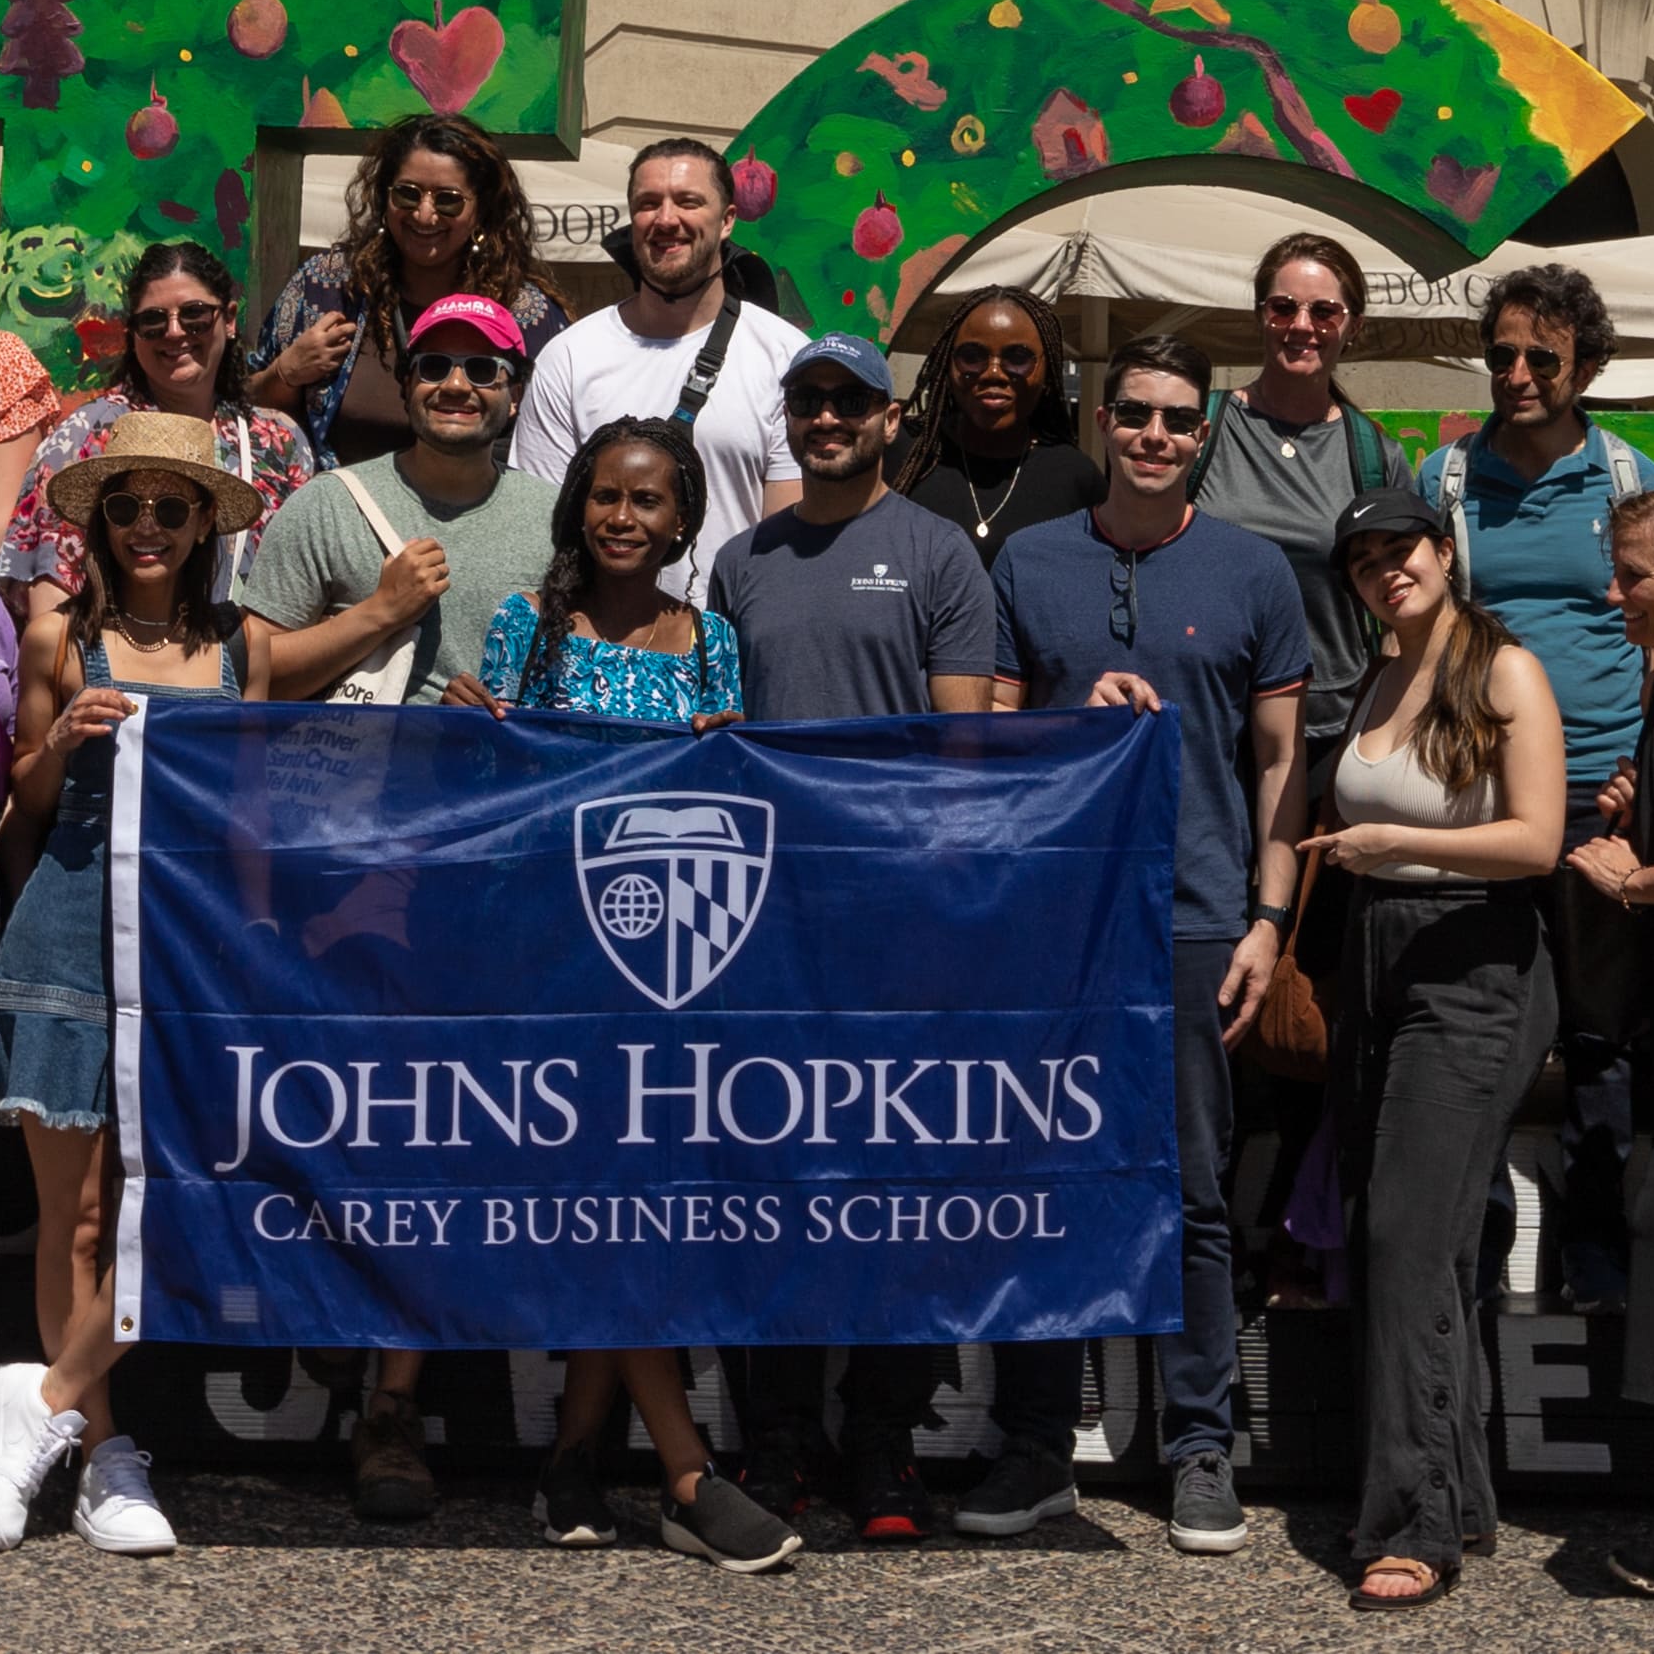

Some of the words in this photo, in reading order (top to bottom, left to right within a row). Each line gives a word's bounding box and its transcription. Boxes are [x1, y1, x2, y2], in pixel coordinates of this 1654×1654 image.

[214, 1043, 579, 1173] JOHNS
[617, 1041, 1104, 1145] HOPKINS
[252, 1193, 459, 1248] CAREY
[483, 1193, 782, 1245] BUSINESS
[806, 1191, 1067, 1245] SCHOOL
